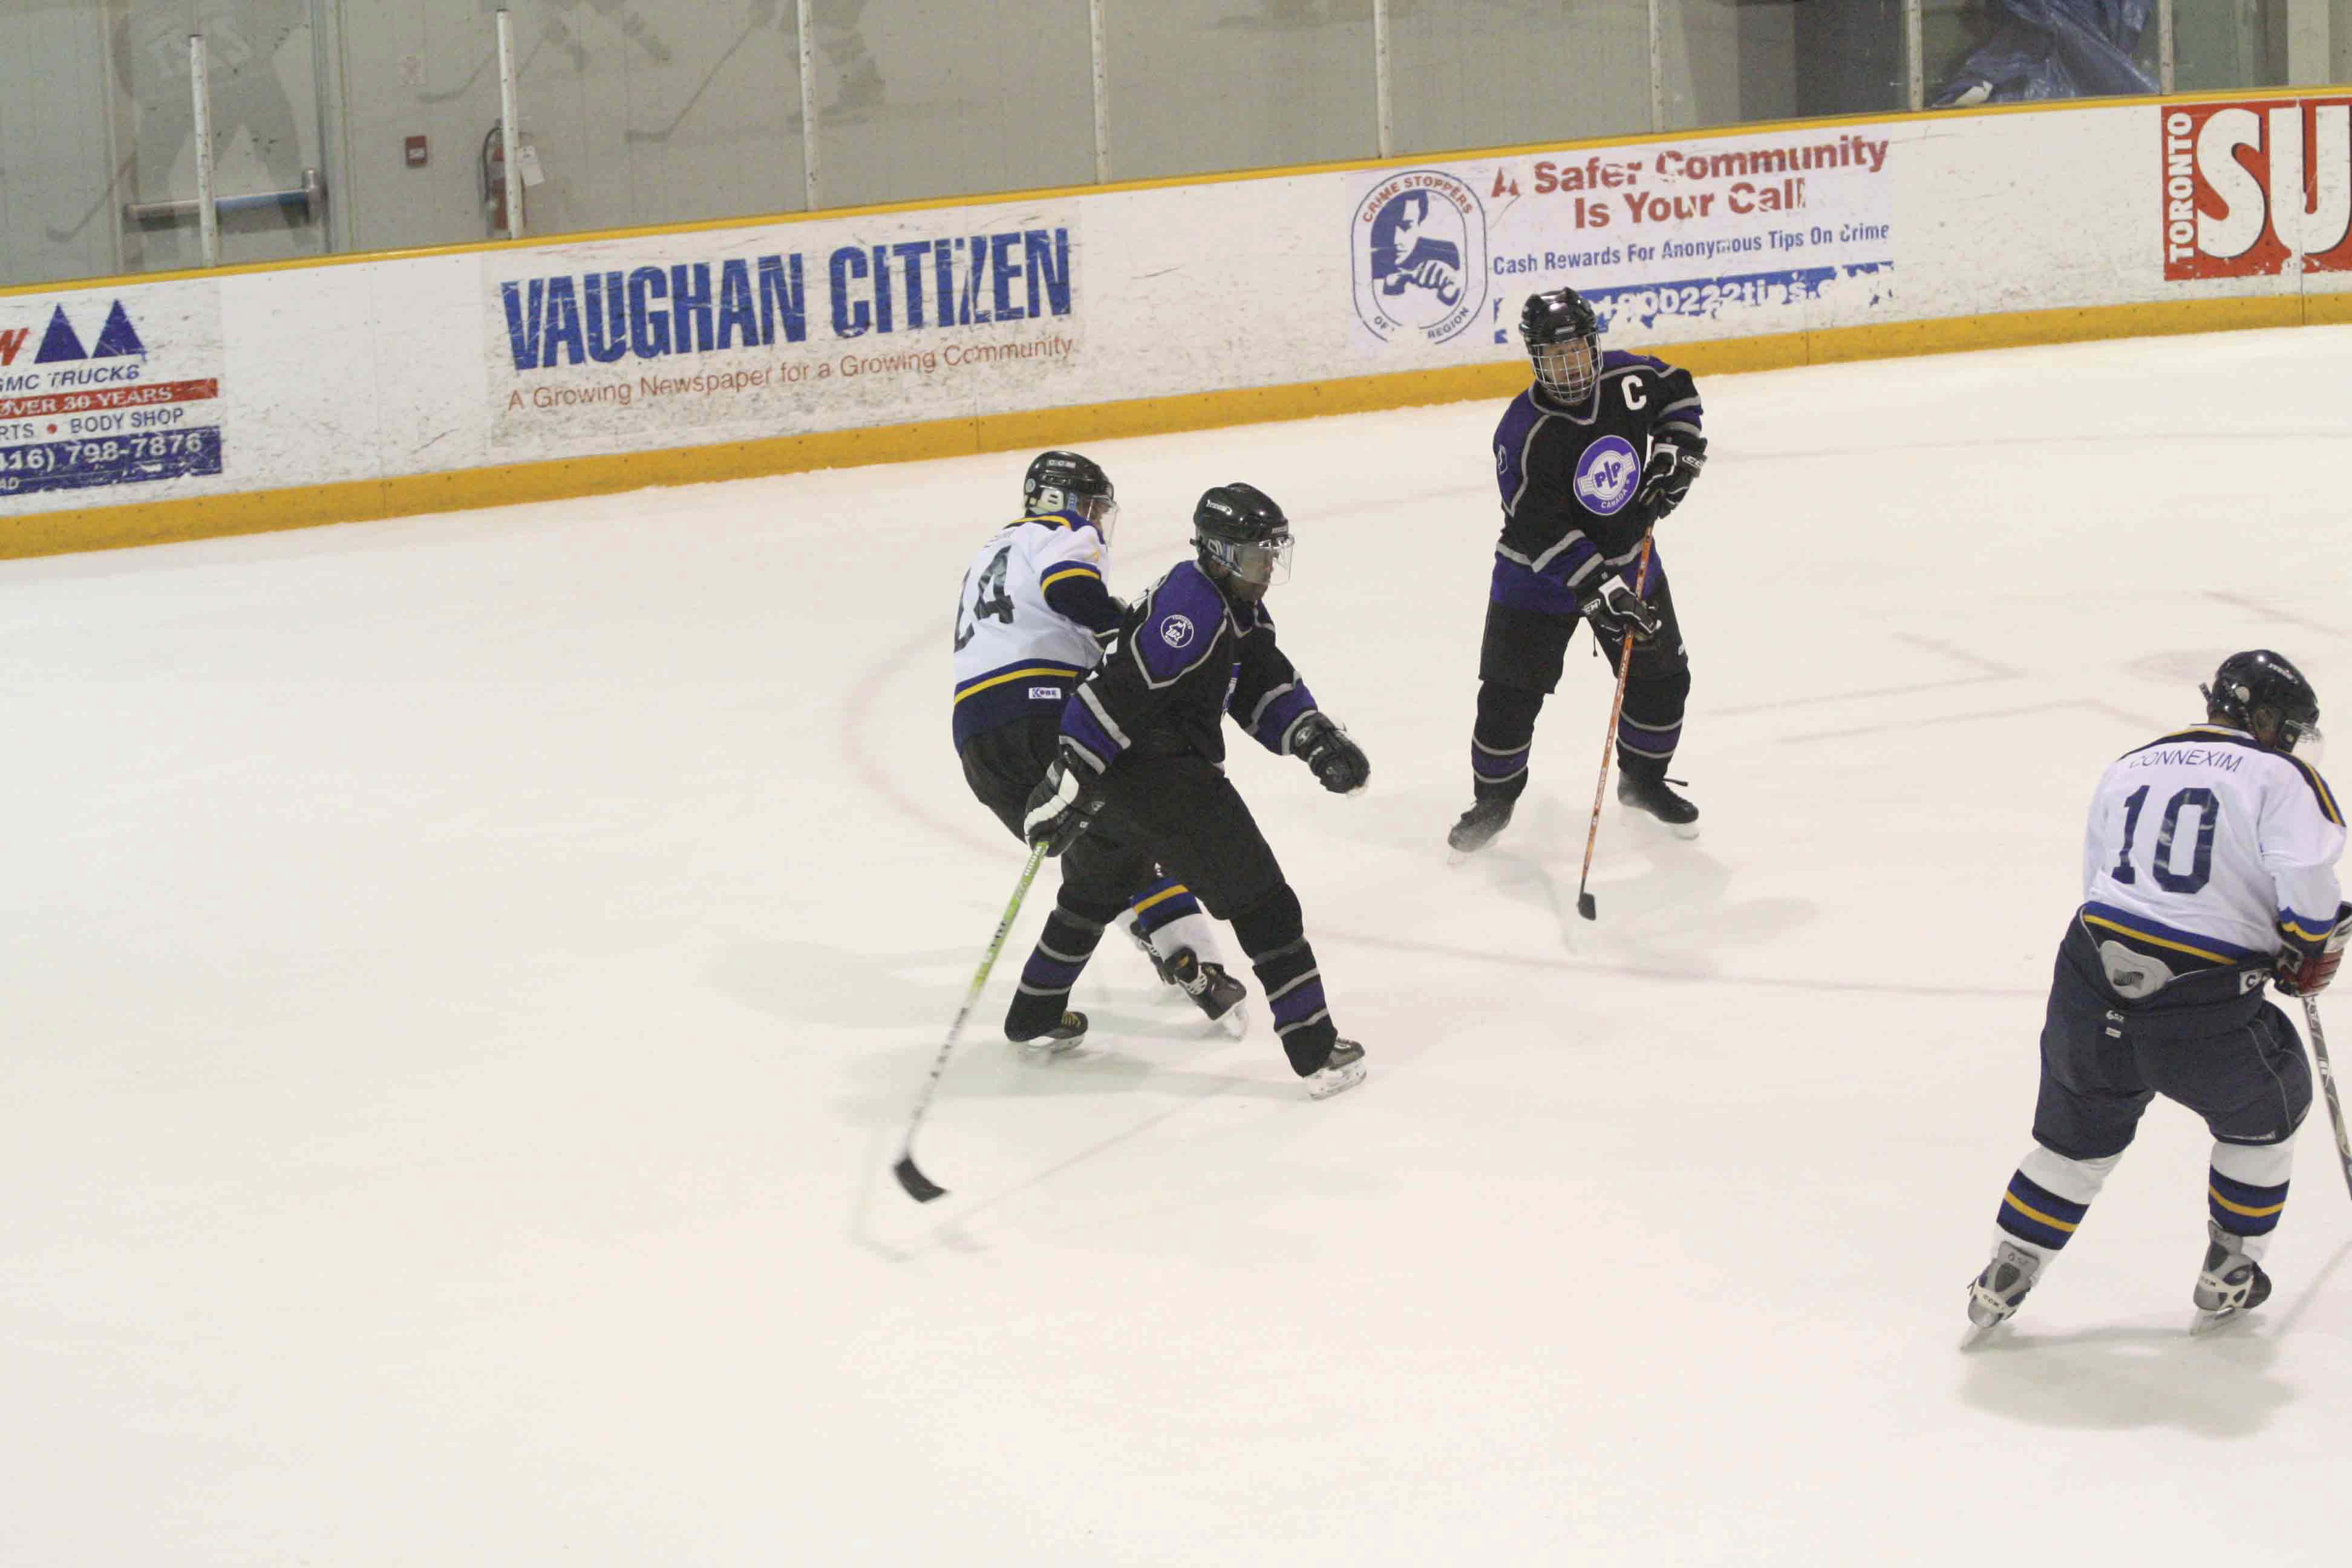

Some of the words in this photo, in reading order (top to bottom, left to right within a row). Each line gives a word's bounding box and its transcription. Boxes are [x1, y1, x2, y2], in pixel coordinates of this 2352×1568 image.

[1534, 156, 1642, 194] Safer
[1655, 135, 1889, 183] Community
[2167, 113, 2194, 264] TORONTO
[2197, 105, 2351, 258] SU
[1363, 182, 1400, 223] CRIME
[1403, 175, 1473, 214] STOPPERS
[1575, 197, 1611, 229] Is
[1623, 191, 1714, 223] Your
[1728, 177, 1806, 214] Call
[1493, 254, 1538, 275] Cash
[1544, 247, 1621, 270] Rewards
[1628, 244, 1655, 262] For
[1662, 235, 1762, 260] Anonymous
[1768, 230, 1805, 252] Tips
[1810, 226, 1833, 244] On
[1840, 223, 1890, 243] Crime
[501, 252, 806, 371] VAUGHAN
[829, 228, 1071, 339] CITIZEN
[1428, 307, 1469, 339] REGION
[48, 364, 140, 387] TRUCKS
[508, 390, 523, 411] A
[533, 382, 632, 408] Growing
[640, 367, 772, 397] Newspaper
[780, 362, 810, 383] for
[818, 363, 832, 379] a
[840, 351, 936, 379] Growing
[944, 336, 1074, 368] Community
[1621, 374, 1647, 410] C
[62, 396, 91, 411] 30
[94, 387, 173, 408] YEARS
[70, 414, 125, 434] BODY
[131, 407, 184, 427] SHOP
[64, 432, 203, 465] 798-7876
[1600, 488, 1628, 509] CANADA
[2112, 785, 2220, 894] 10
